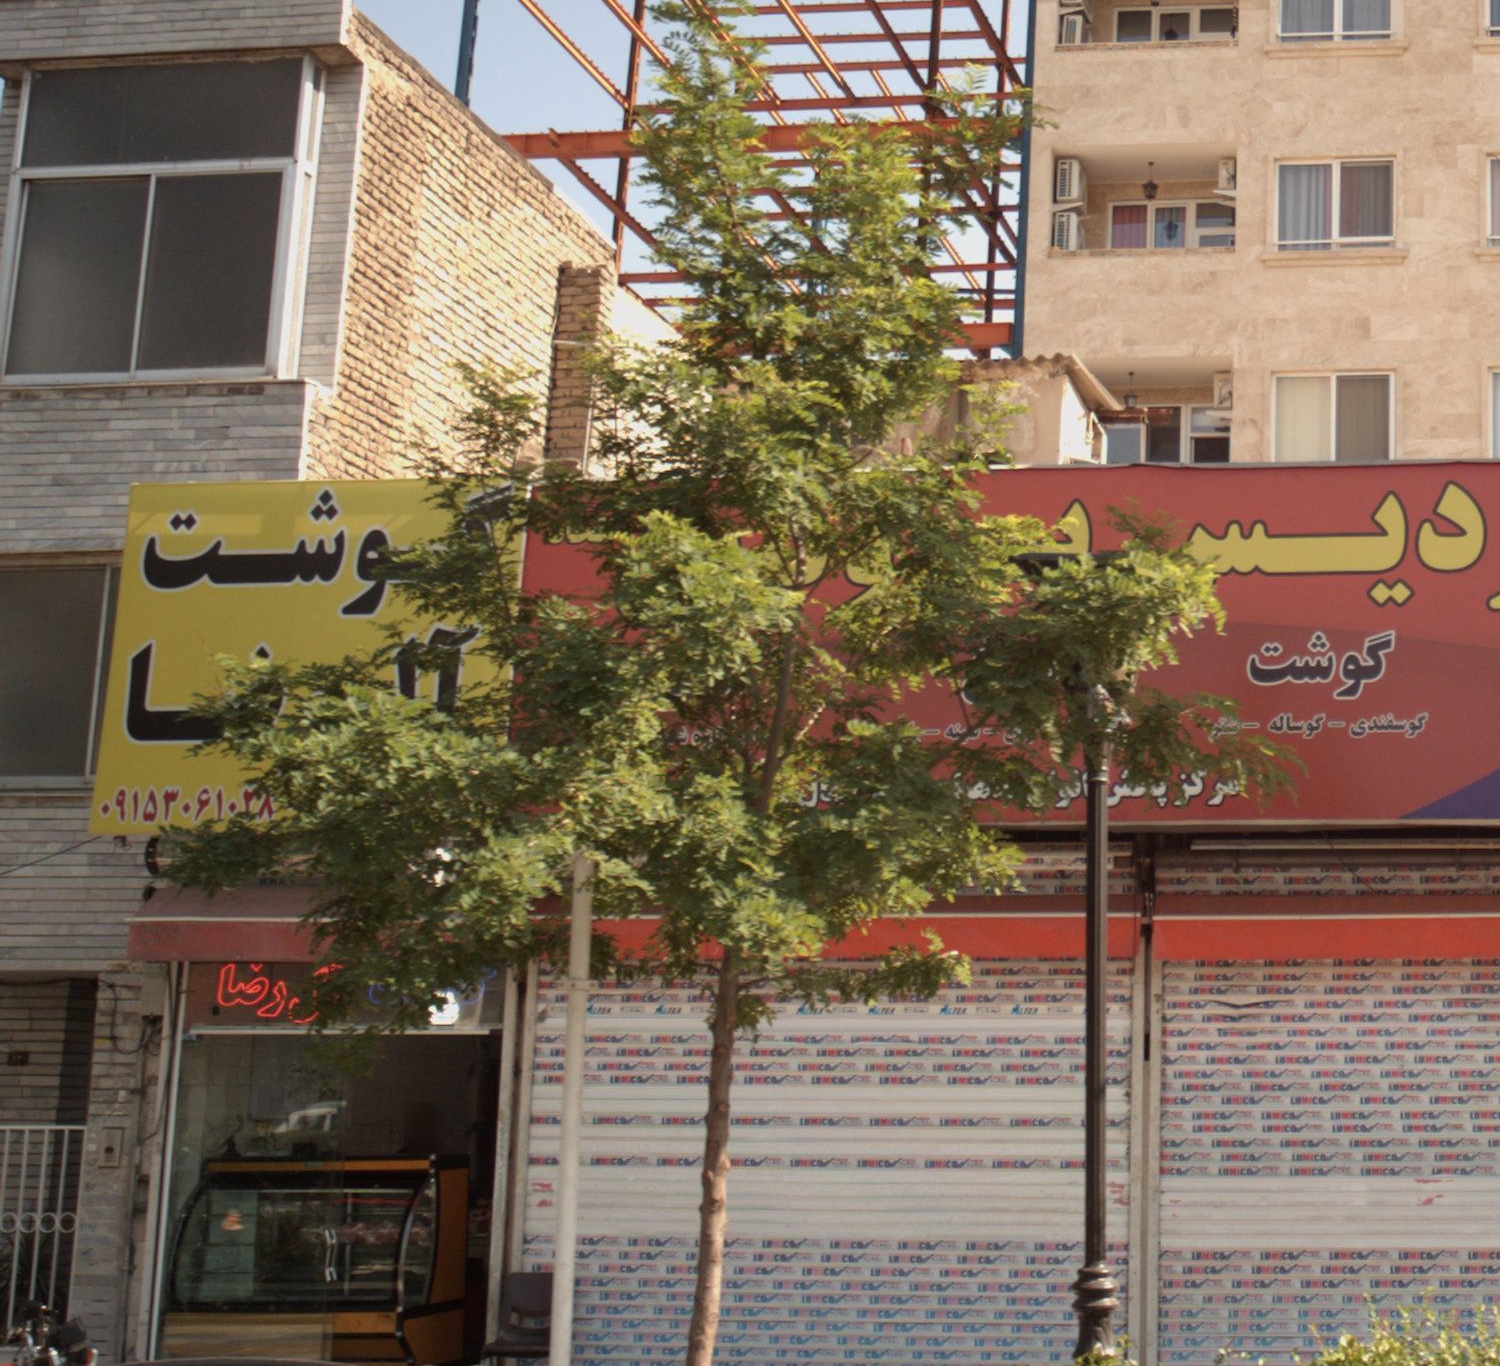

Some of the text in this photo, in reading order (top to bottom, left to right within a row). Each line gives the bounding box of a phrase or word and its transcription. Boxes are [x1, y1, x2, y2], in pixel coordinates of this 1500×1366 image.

[1247, 630, 1395, 699] گوشت
[1268, 712, 1326, 739] گوساله
[1350, 711, 1428, 738] گوسفندی
